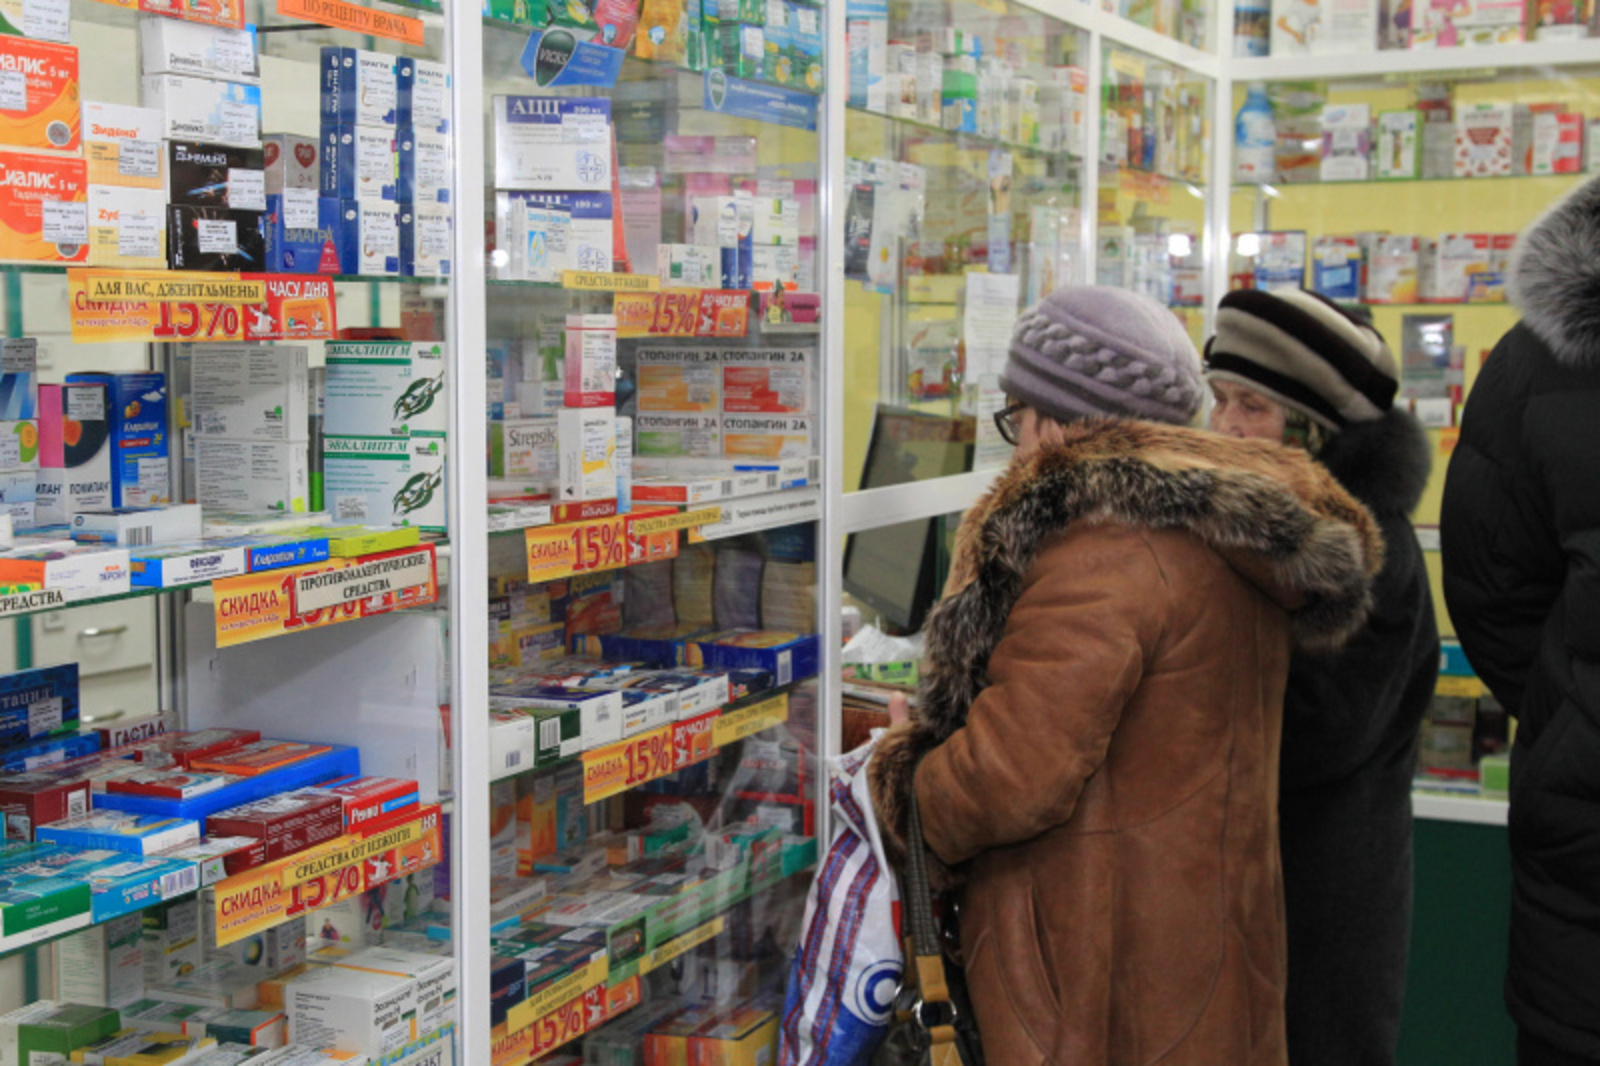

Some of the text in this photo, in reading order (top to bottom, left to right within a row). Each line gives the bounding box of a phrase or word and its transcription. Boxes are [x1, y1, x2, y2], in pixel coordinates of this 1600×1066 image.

[373, 14, 407, 35] ВРАЧА
[91, 124, 137, 139] Зидена
[95, 281, 122, 296] ДЛЯ
[156, 283, 259, 298] ДЖЕНТЛЬМЕНЫ
[269, 281, 329, 299] ЧАСУ ДНЯ
[647, 292, 696, 334] 15%
[531, 521, 622, 572] СКИДКА 15%
[300, 553, 427, 591] ПРОТИВОАЛЛЕРГИЧЕСКИЕ
[220, 589, 279, 618] СКИДКА
[343, 578, 391, 599] СРЕДСТВА
[587, 731, 671, 785] СКИДКА 15%
[295, 854, 349, 879] СРЕДСТВА
[351, 845, 366, 859] ОТ
[221, 880, 281, 917] СКИДКА
